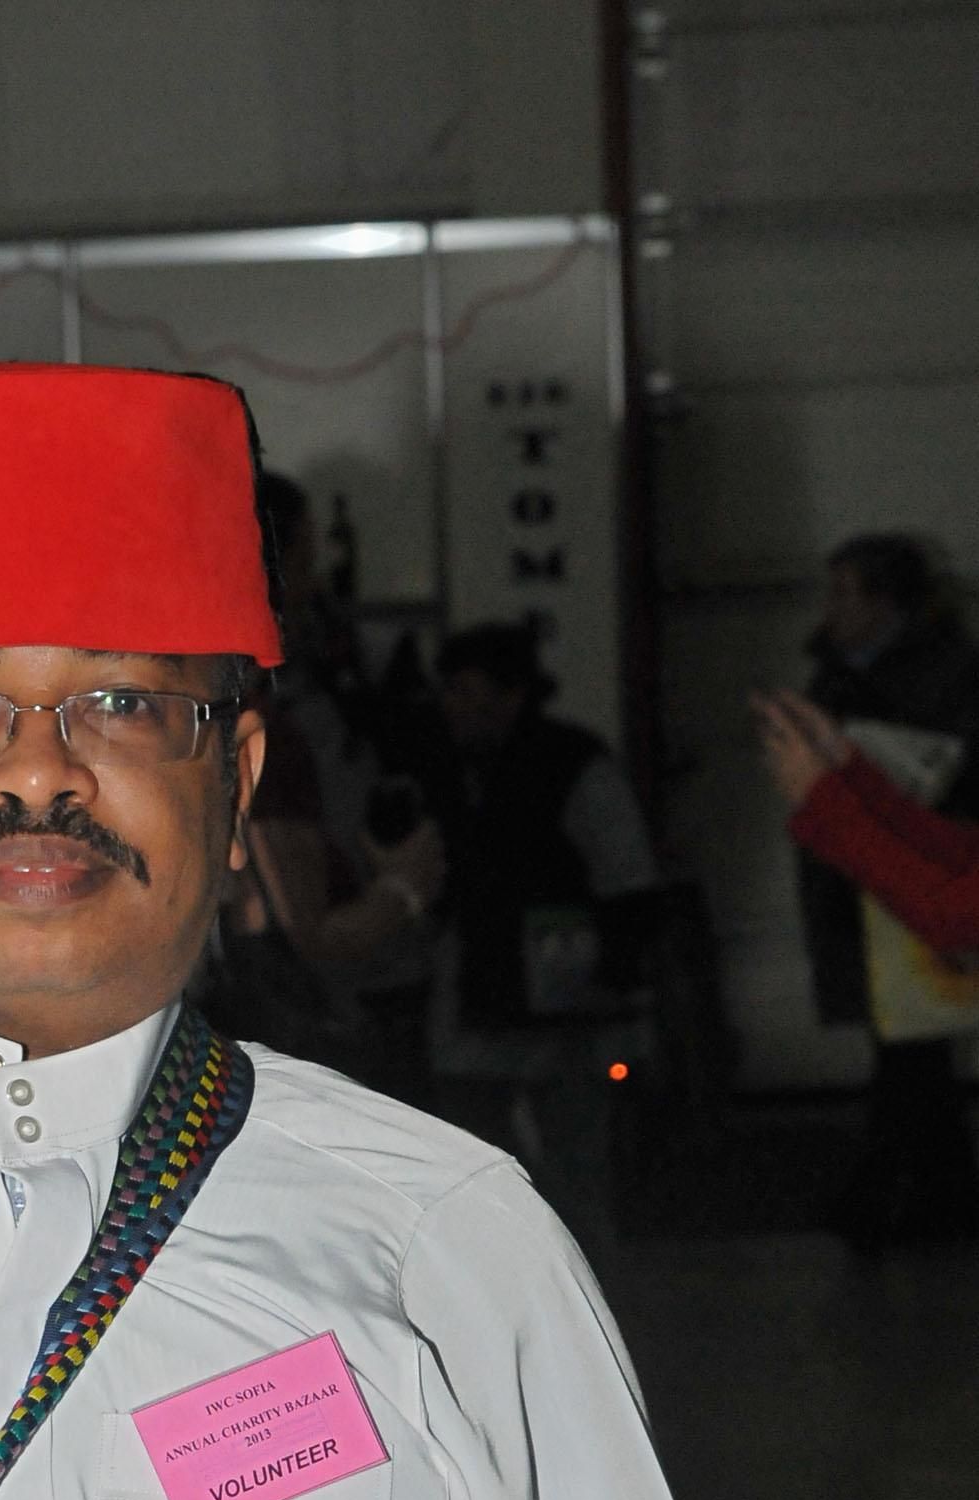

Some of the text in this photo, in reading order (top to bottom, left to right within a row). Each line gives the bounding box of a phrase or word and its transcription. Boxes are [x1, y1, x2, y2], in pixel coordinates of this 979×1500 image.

[205, 1381, 277, 1416] IWC SOFIA
[165, 1383, 340, 1463] ANNUAL CHARITY BAZAAR
[244, 1428, 272, 1448] 2013
